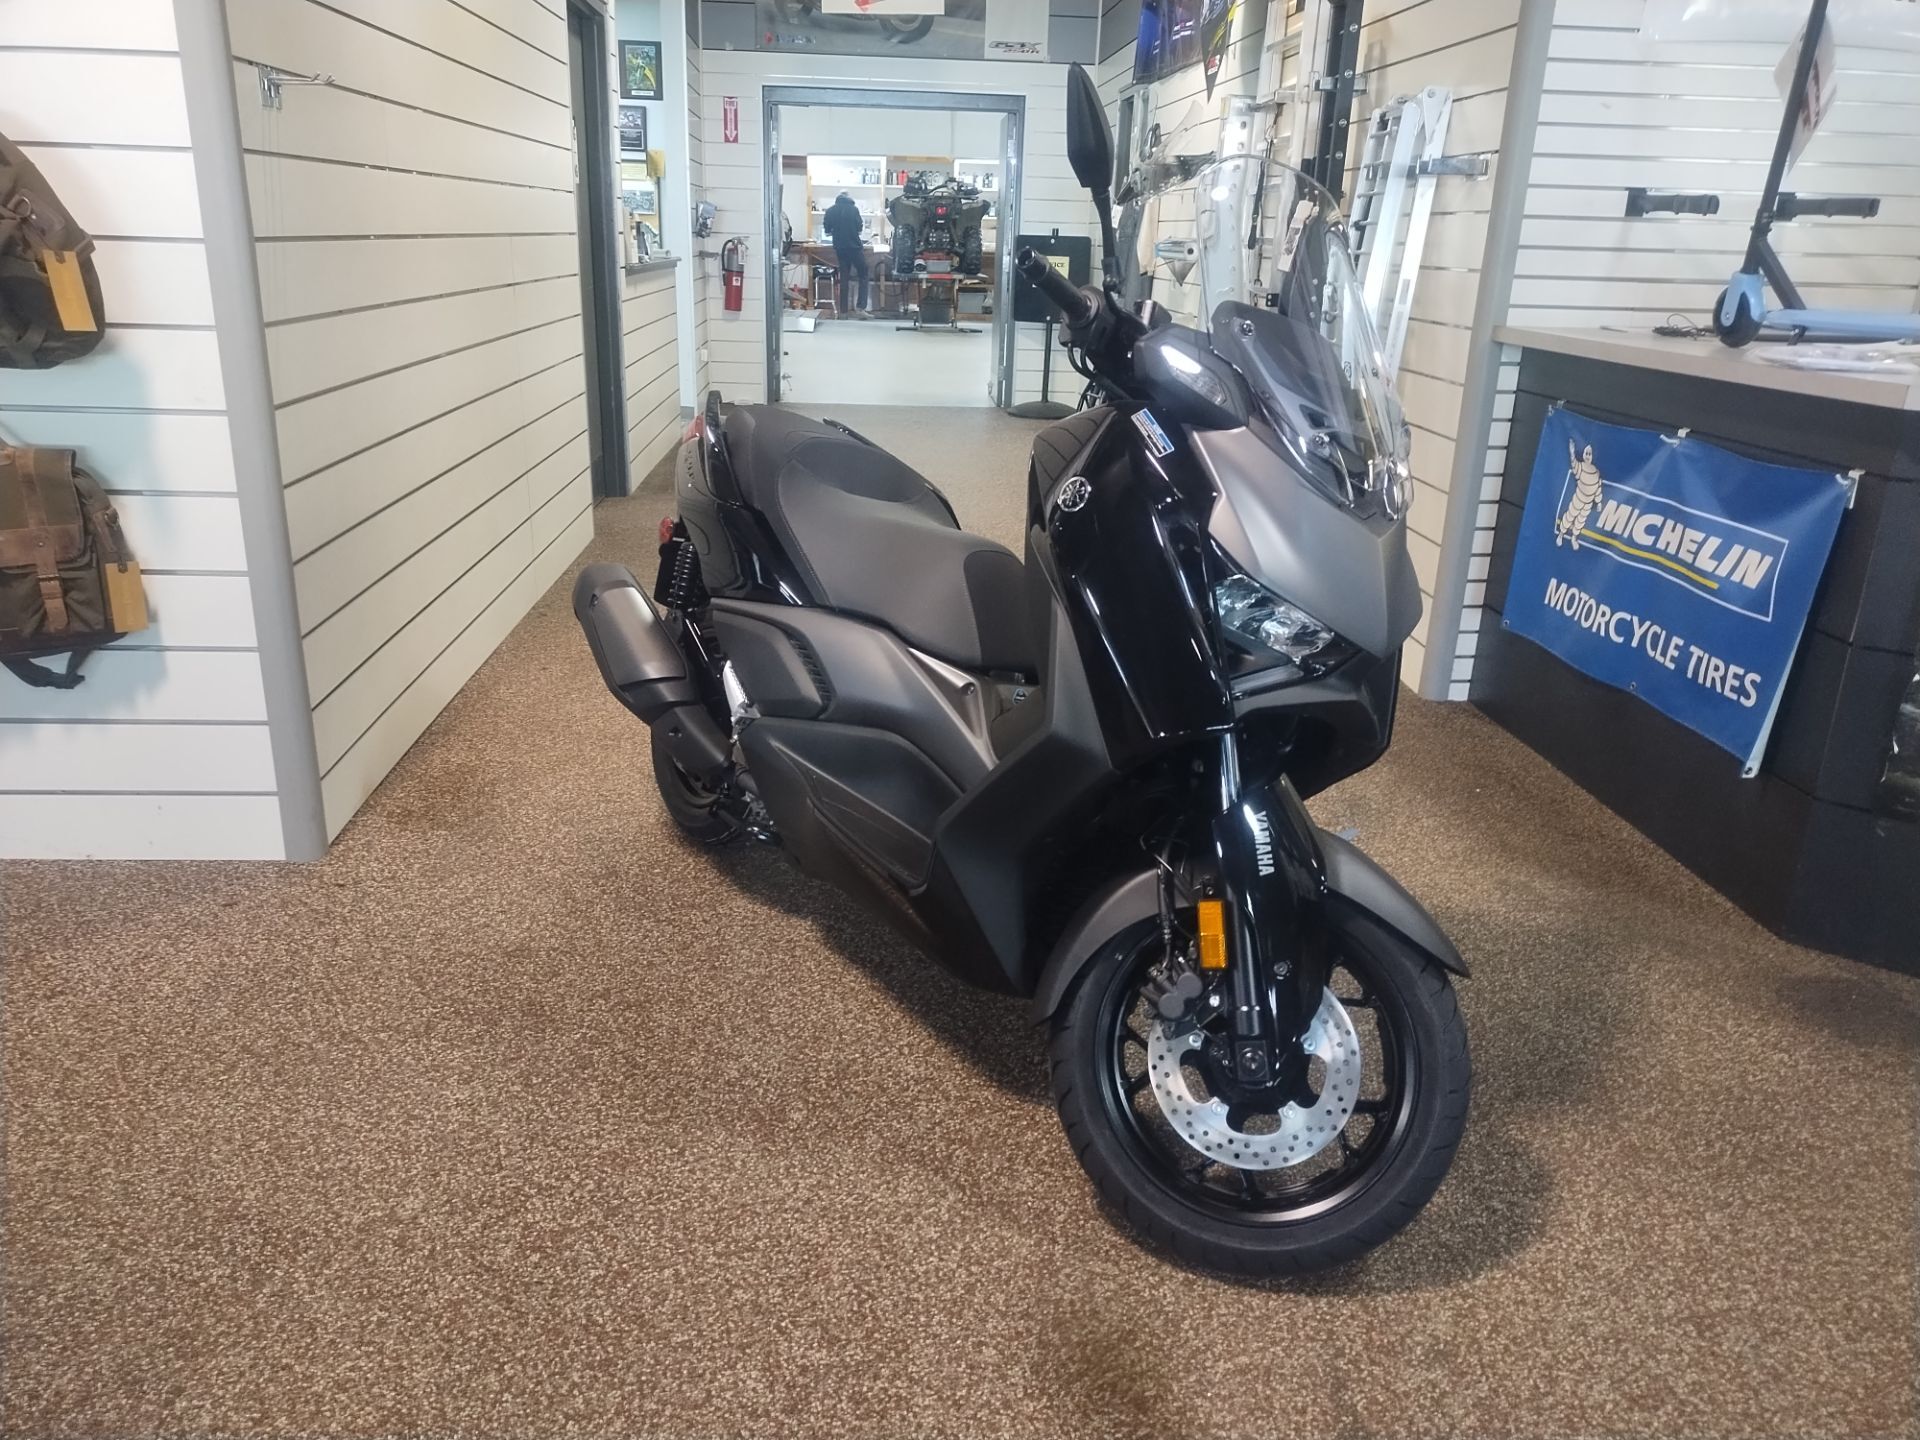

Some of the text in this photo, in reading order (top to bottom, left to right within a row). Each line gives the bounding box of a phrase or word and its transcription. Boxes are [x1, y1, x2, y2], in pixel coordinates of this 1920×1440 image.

[1596, 499, 1773, 589] MICHELIN
[1544, 578, 1762, 708] MOTORCYCLE TIRES
[1255, 811, 1275, 876] YAMAHA
